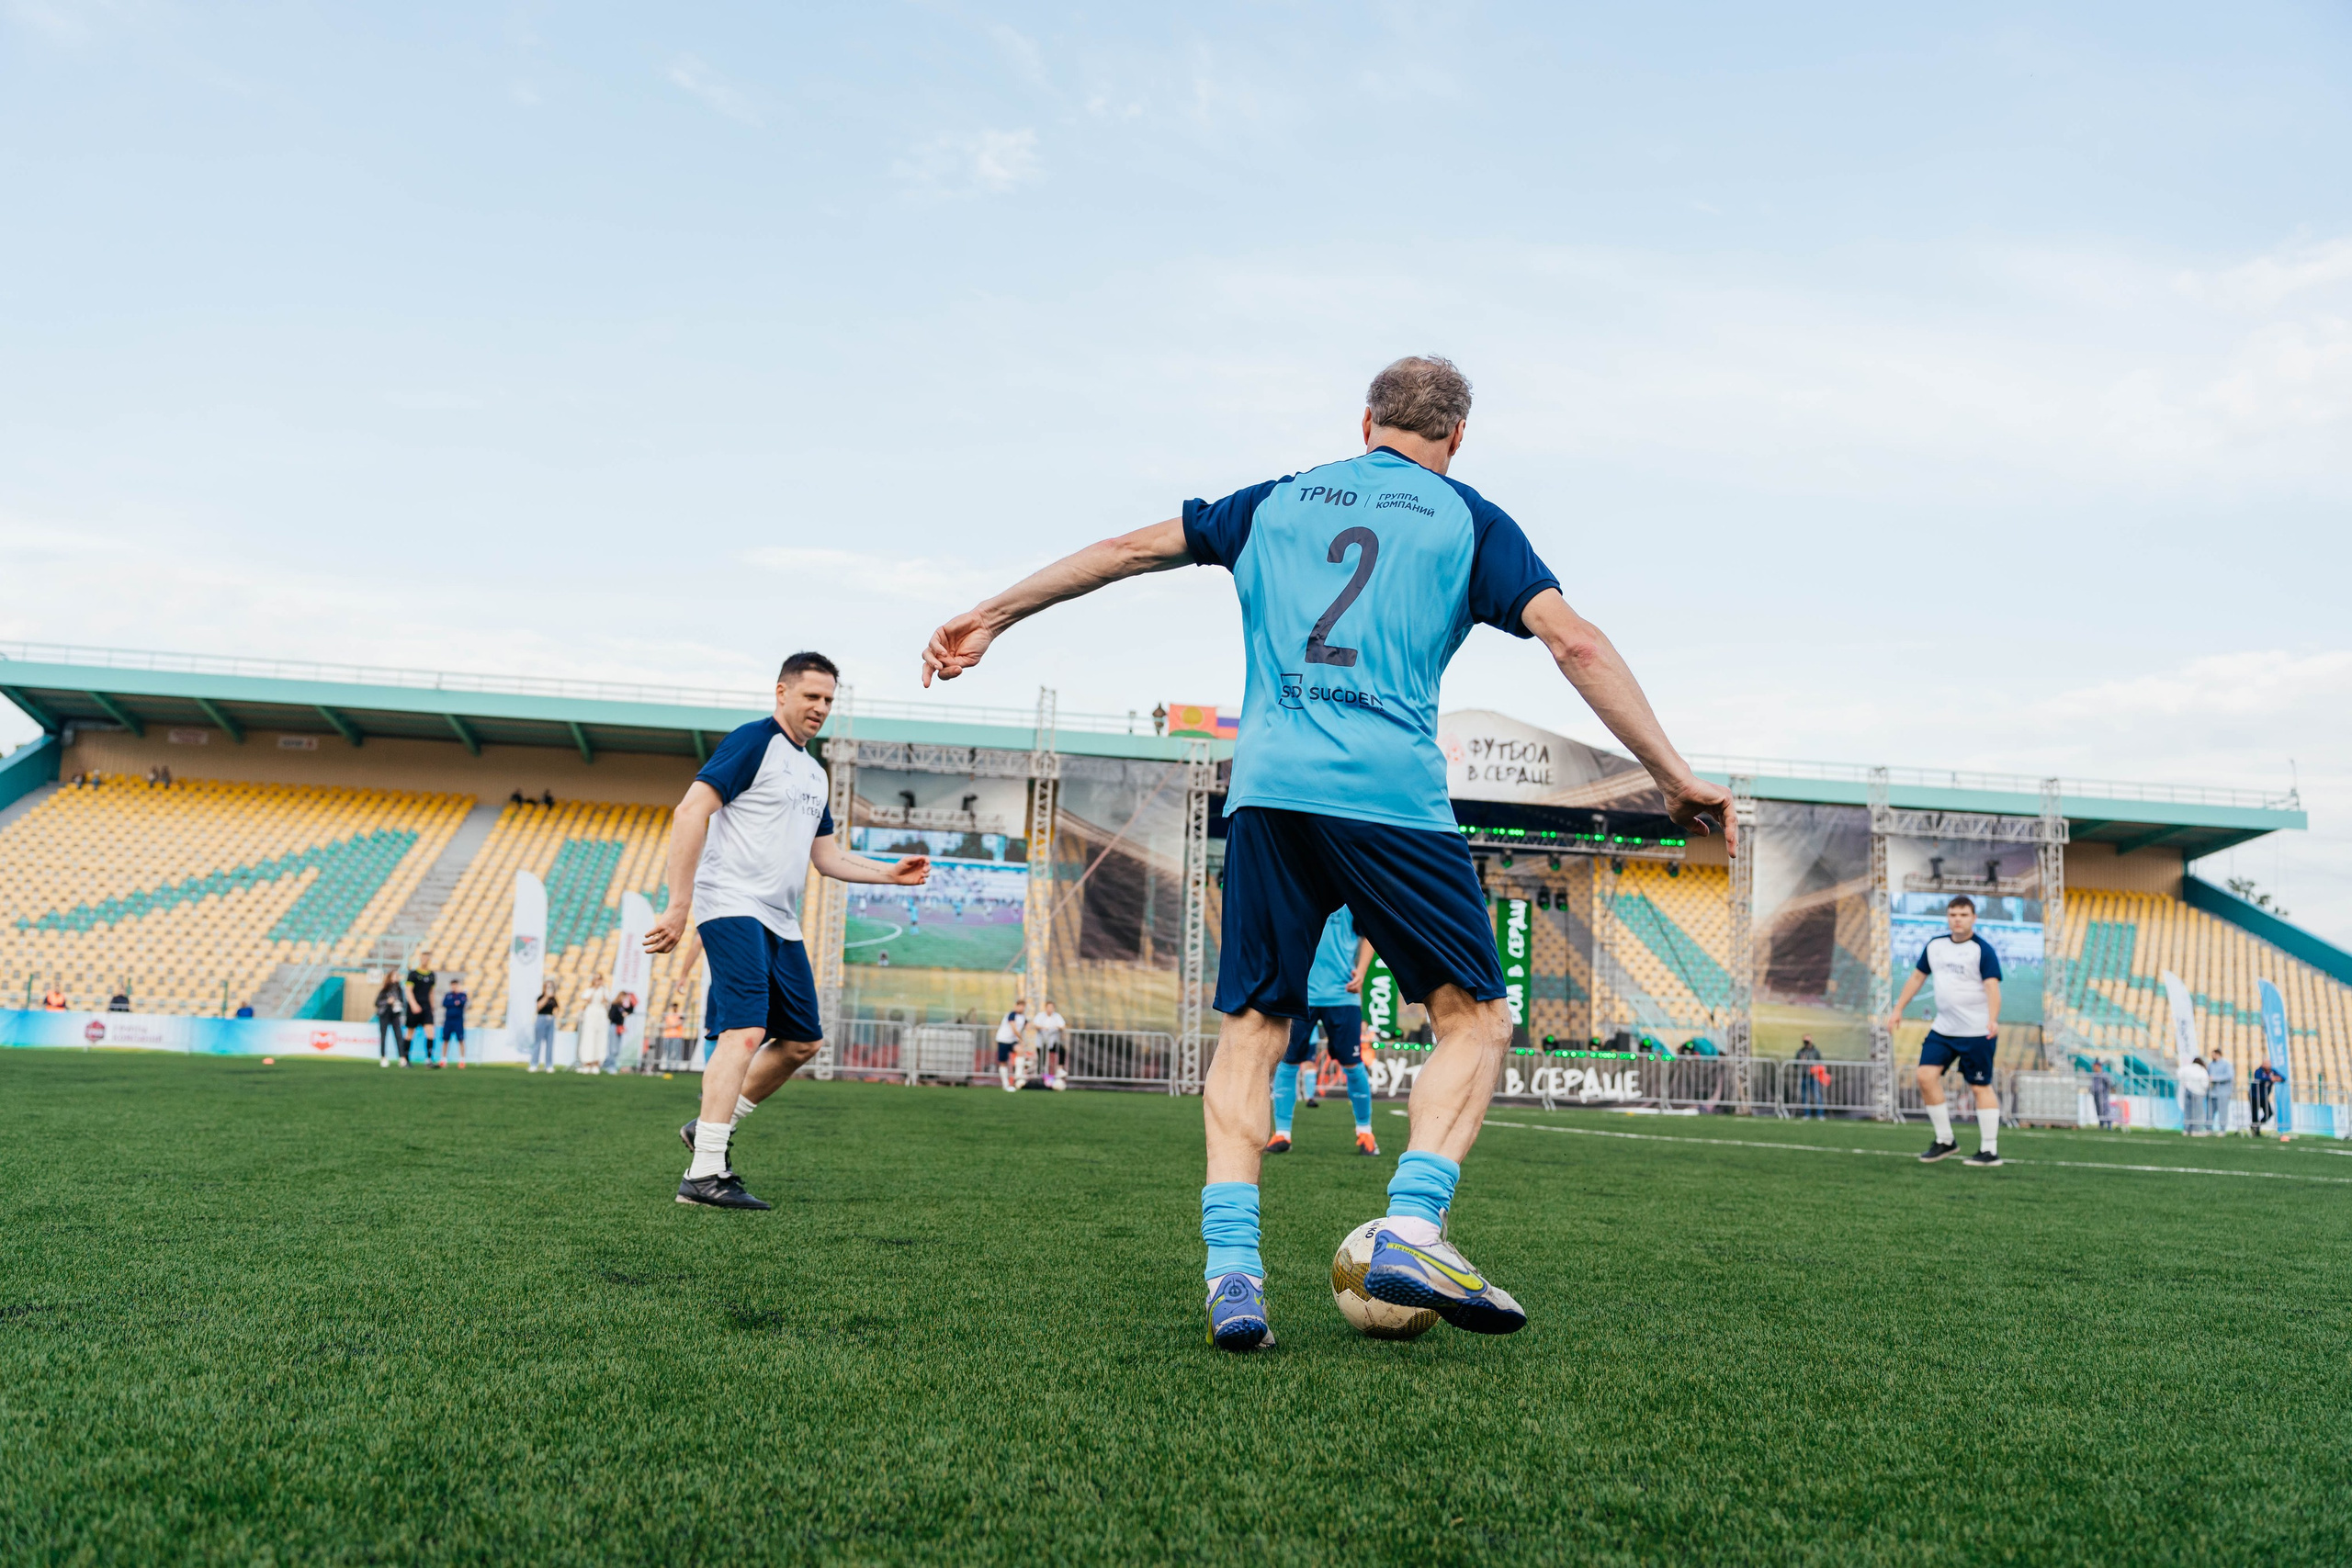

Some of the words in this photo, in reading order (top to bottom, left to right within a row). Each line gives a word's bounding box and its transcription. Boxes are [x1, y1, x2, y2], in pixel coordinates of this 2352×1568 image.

[1299, 486, 1358, 506] ТРИО
[1378, 492, 1419, 503] ГРУППА
[1375, 501, 1436, 517] КОМПАНИЙ
[1305, 526, 1380, 668] 2
[1309, 687, 1384, 706] SUCDEN
[1468, 739, 1550, 764] ФУТБОЛ
[1468, 765, 1479, 781] В
[1484, 766, 1555, 785] СЕРДЦЕ
[1507, 899, 1528, 959] СЕРДЦ
[1507, 964, 1525, 978] В
[1506, 1067, 1525, 1097] В
[1530, 1066, 1643, 1103] СЕРДЦЕ
